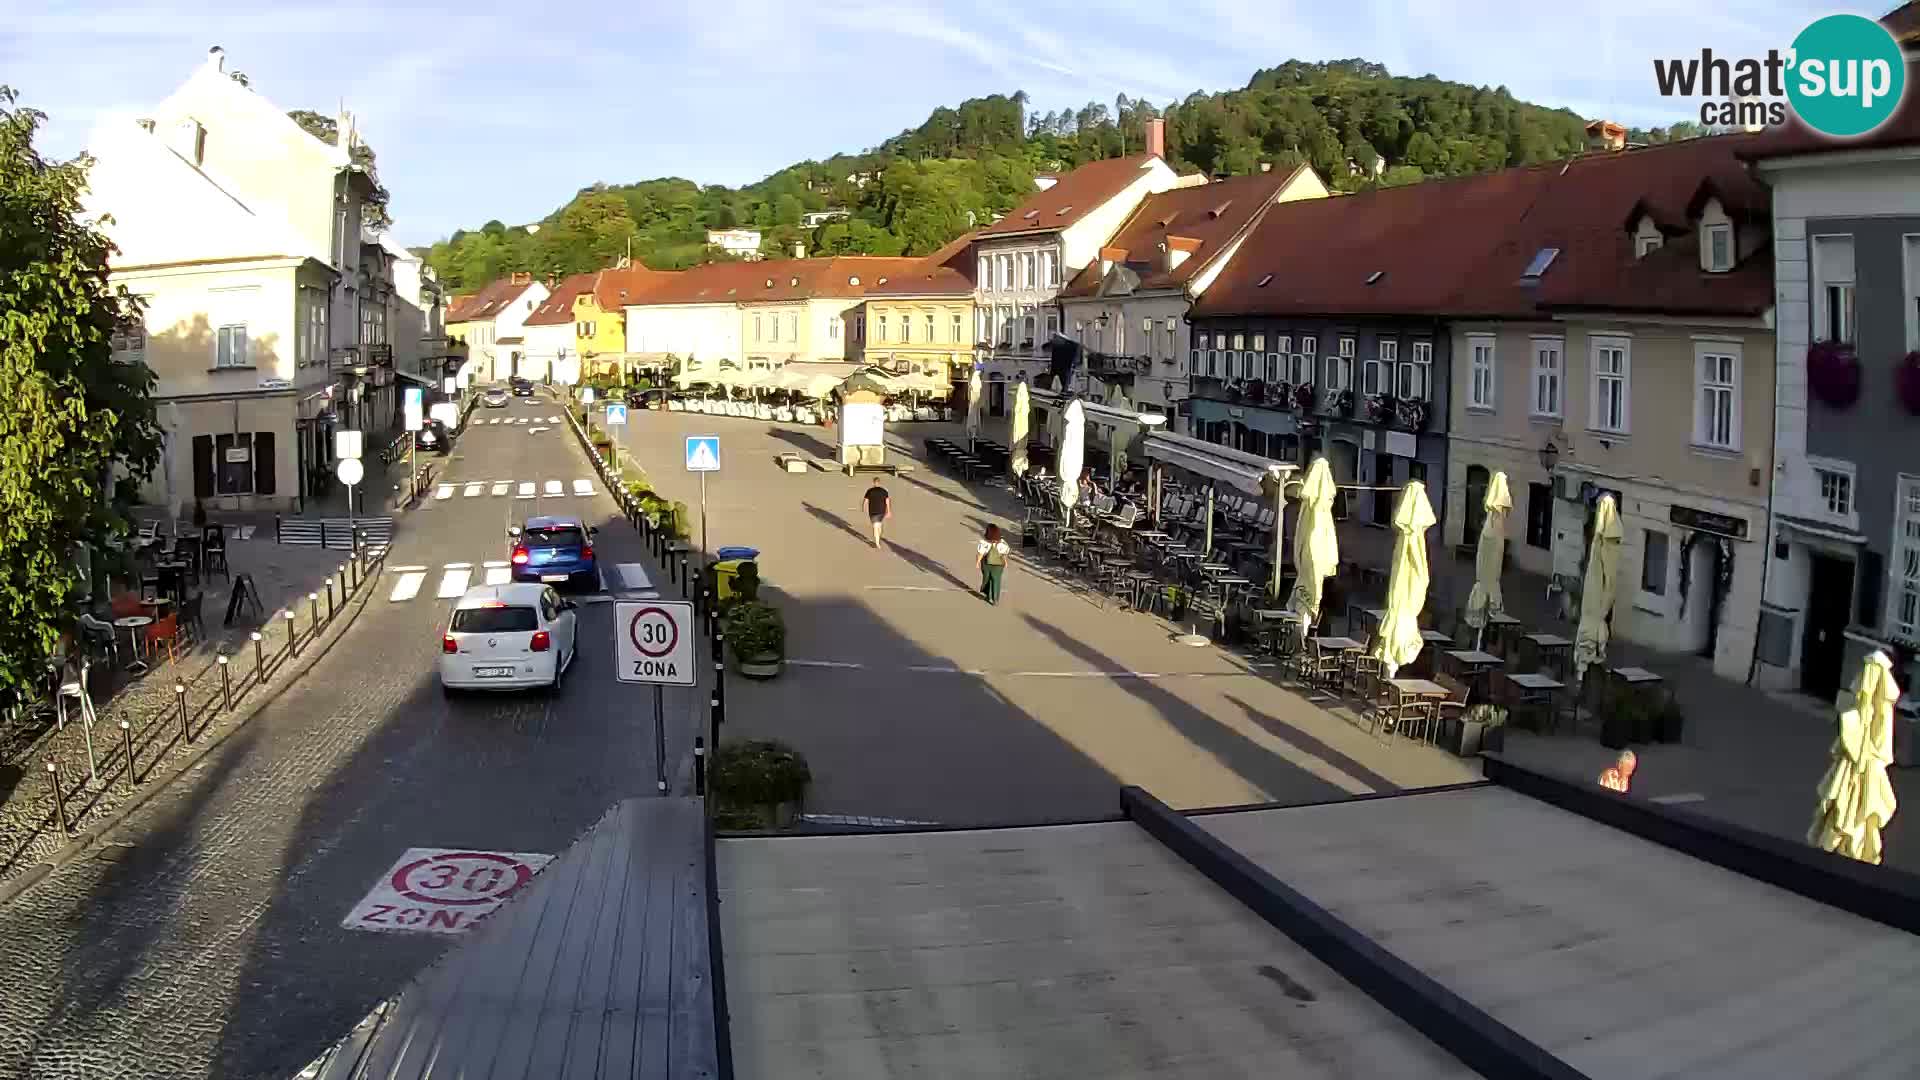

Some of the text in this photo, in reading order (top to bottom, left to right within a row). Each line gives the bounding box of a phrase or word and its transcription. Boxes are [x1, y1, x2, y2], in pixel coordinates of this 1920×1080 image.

[643, 623, 667, 644] 30
[633, 661, 677, 677] ZONA
[419, 864, 504, 893] 30
[361, 904, 481, 929] ZON
